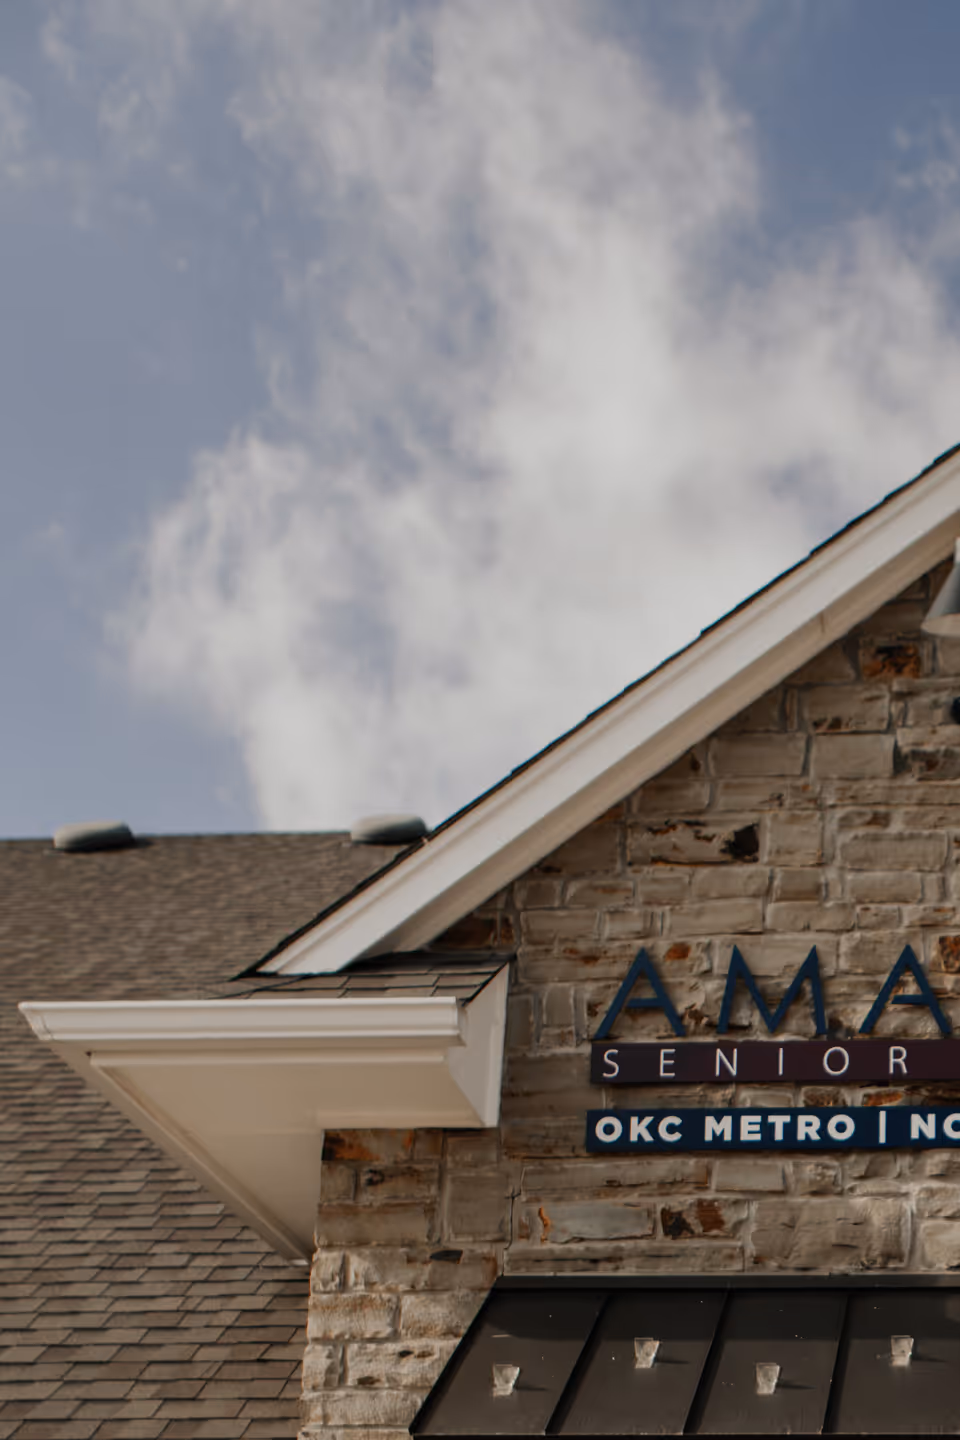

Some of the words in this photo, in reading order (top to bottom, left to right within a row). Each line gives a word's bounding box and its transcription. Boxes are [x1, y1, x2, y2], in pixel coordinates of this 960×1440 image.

[602, 1045, 908, 1079] SENIOR
[595, 1115, 683, 1143] OKC
[704, 1113, 856, 1141] METRO
